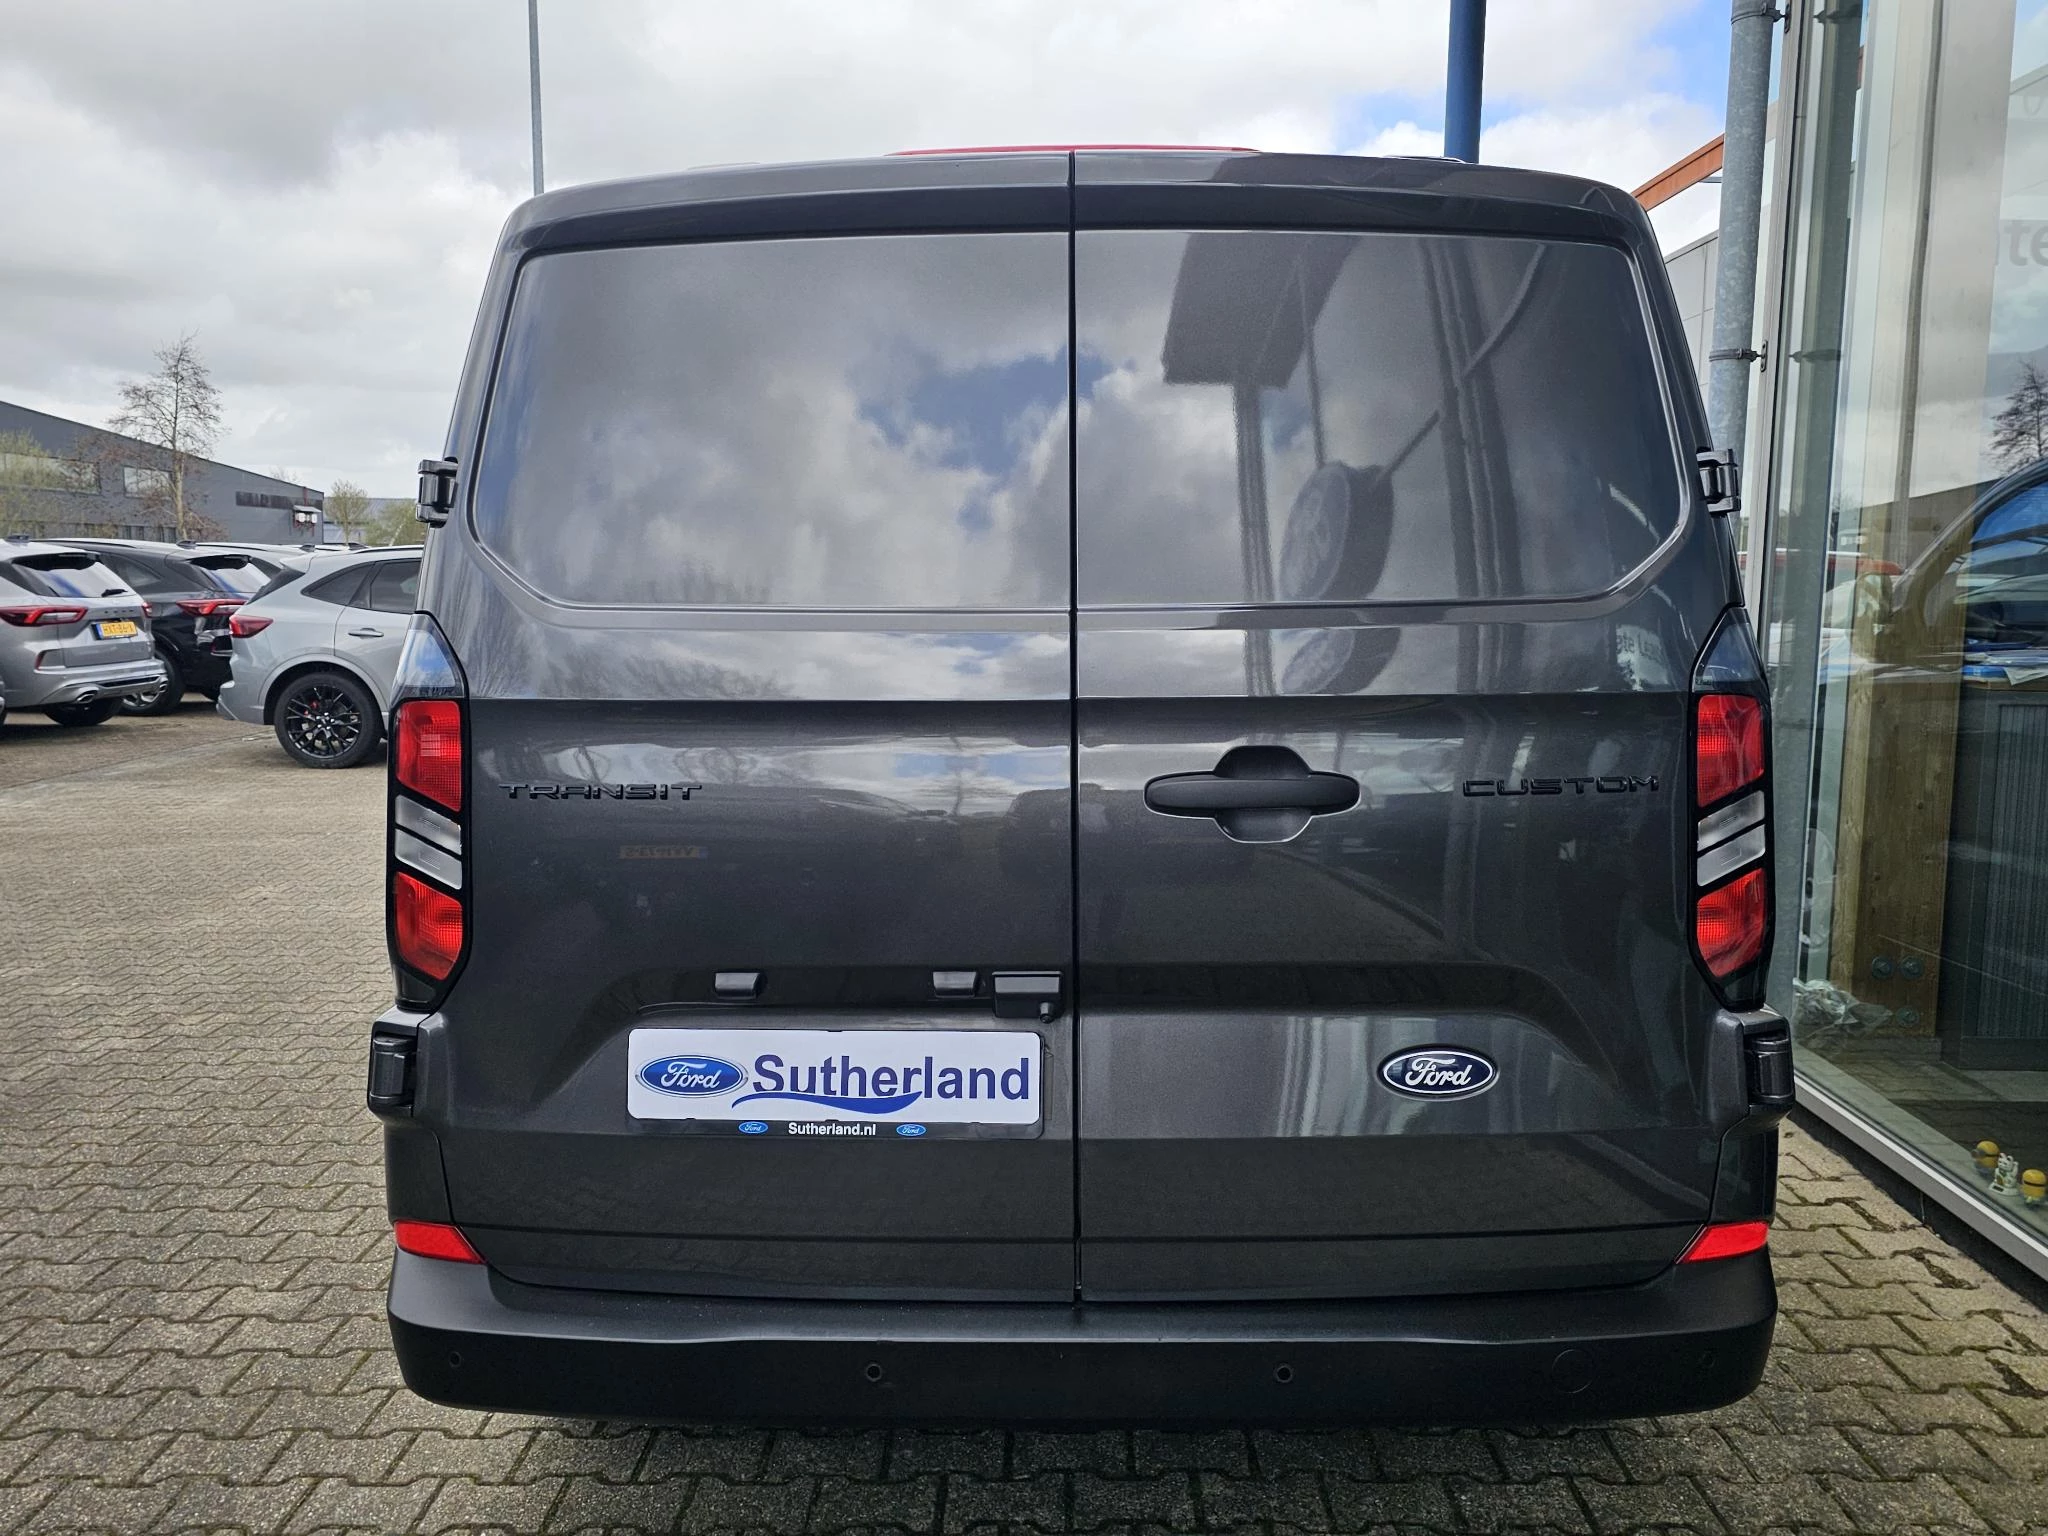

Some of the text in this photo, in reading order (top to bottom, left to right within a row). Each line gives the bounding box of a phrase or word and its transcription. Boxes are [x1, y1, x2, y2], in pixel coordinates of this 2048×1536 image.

[499, 783, 702, 800] TRANSIT
[1463, 775, 1659, 797] CUSTOM
[661, 1054, 1029, 1100] Ford Sutherland
[1405, 1057, 1472, 1086] Ford
[788, 1122, 876, 1136] Sutherland.nl
